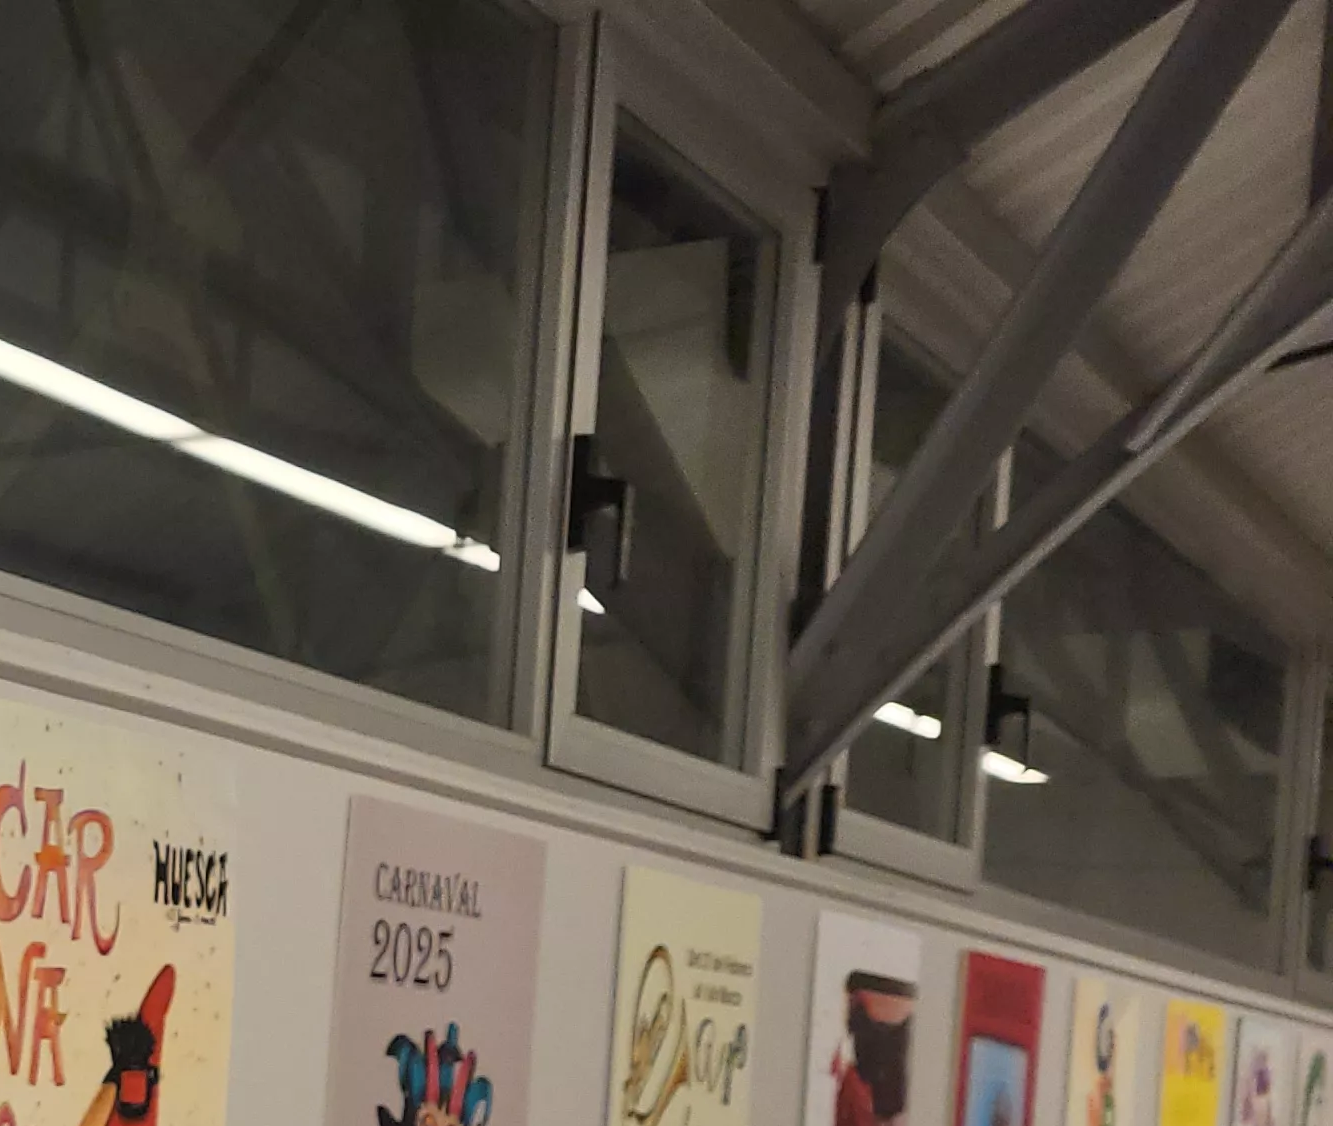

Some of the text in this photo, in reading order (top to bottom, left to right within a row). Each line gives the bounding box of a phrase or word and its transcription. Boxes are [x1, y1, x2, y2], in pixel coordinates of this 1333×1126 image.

[152, 838, 229, 917] HUESCA
[375, 861, 482, 919] CARNAVAL
[370, 918, 455, 992] 2025
